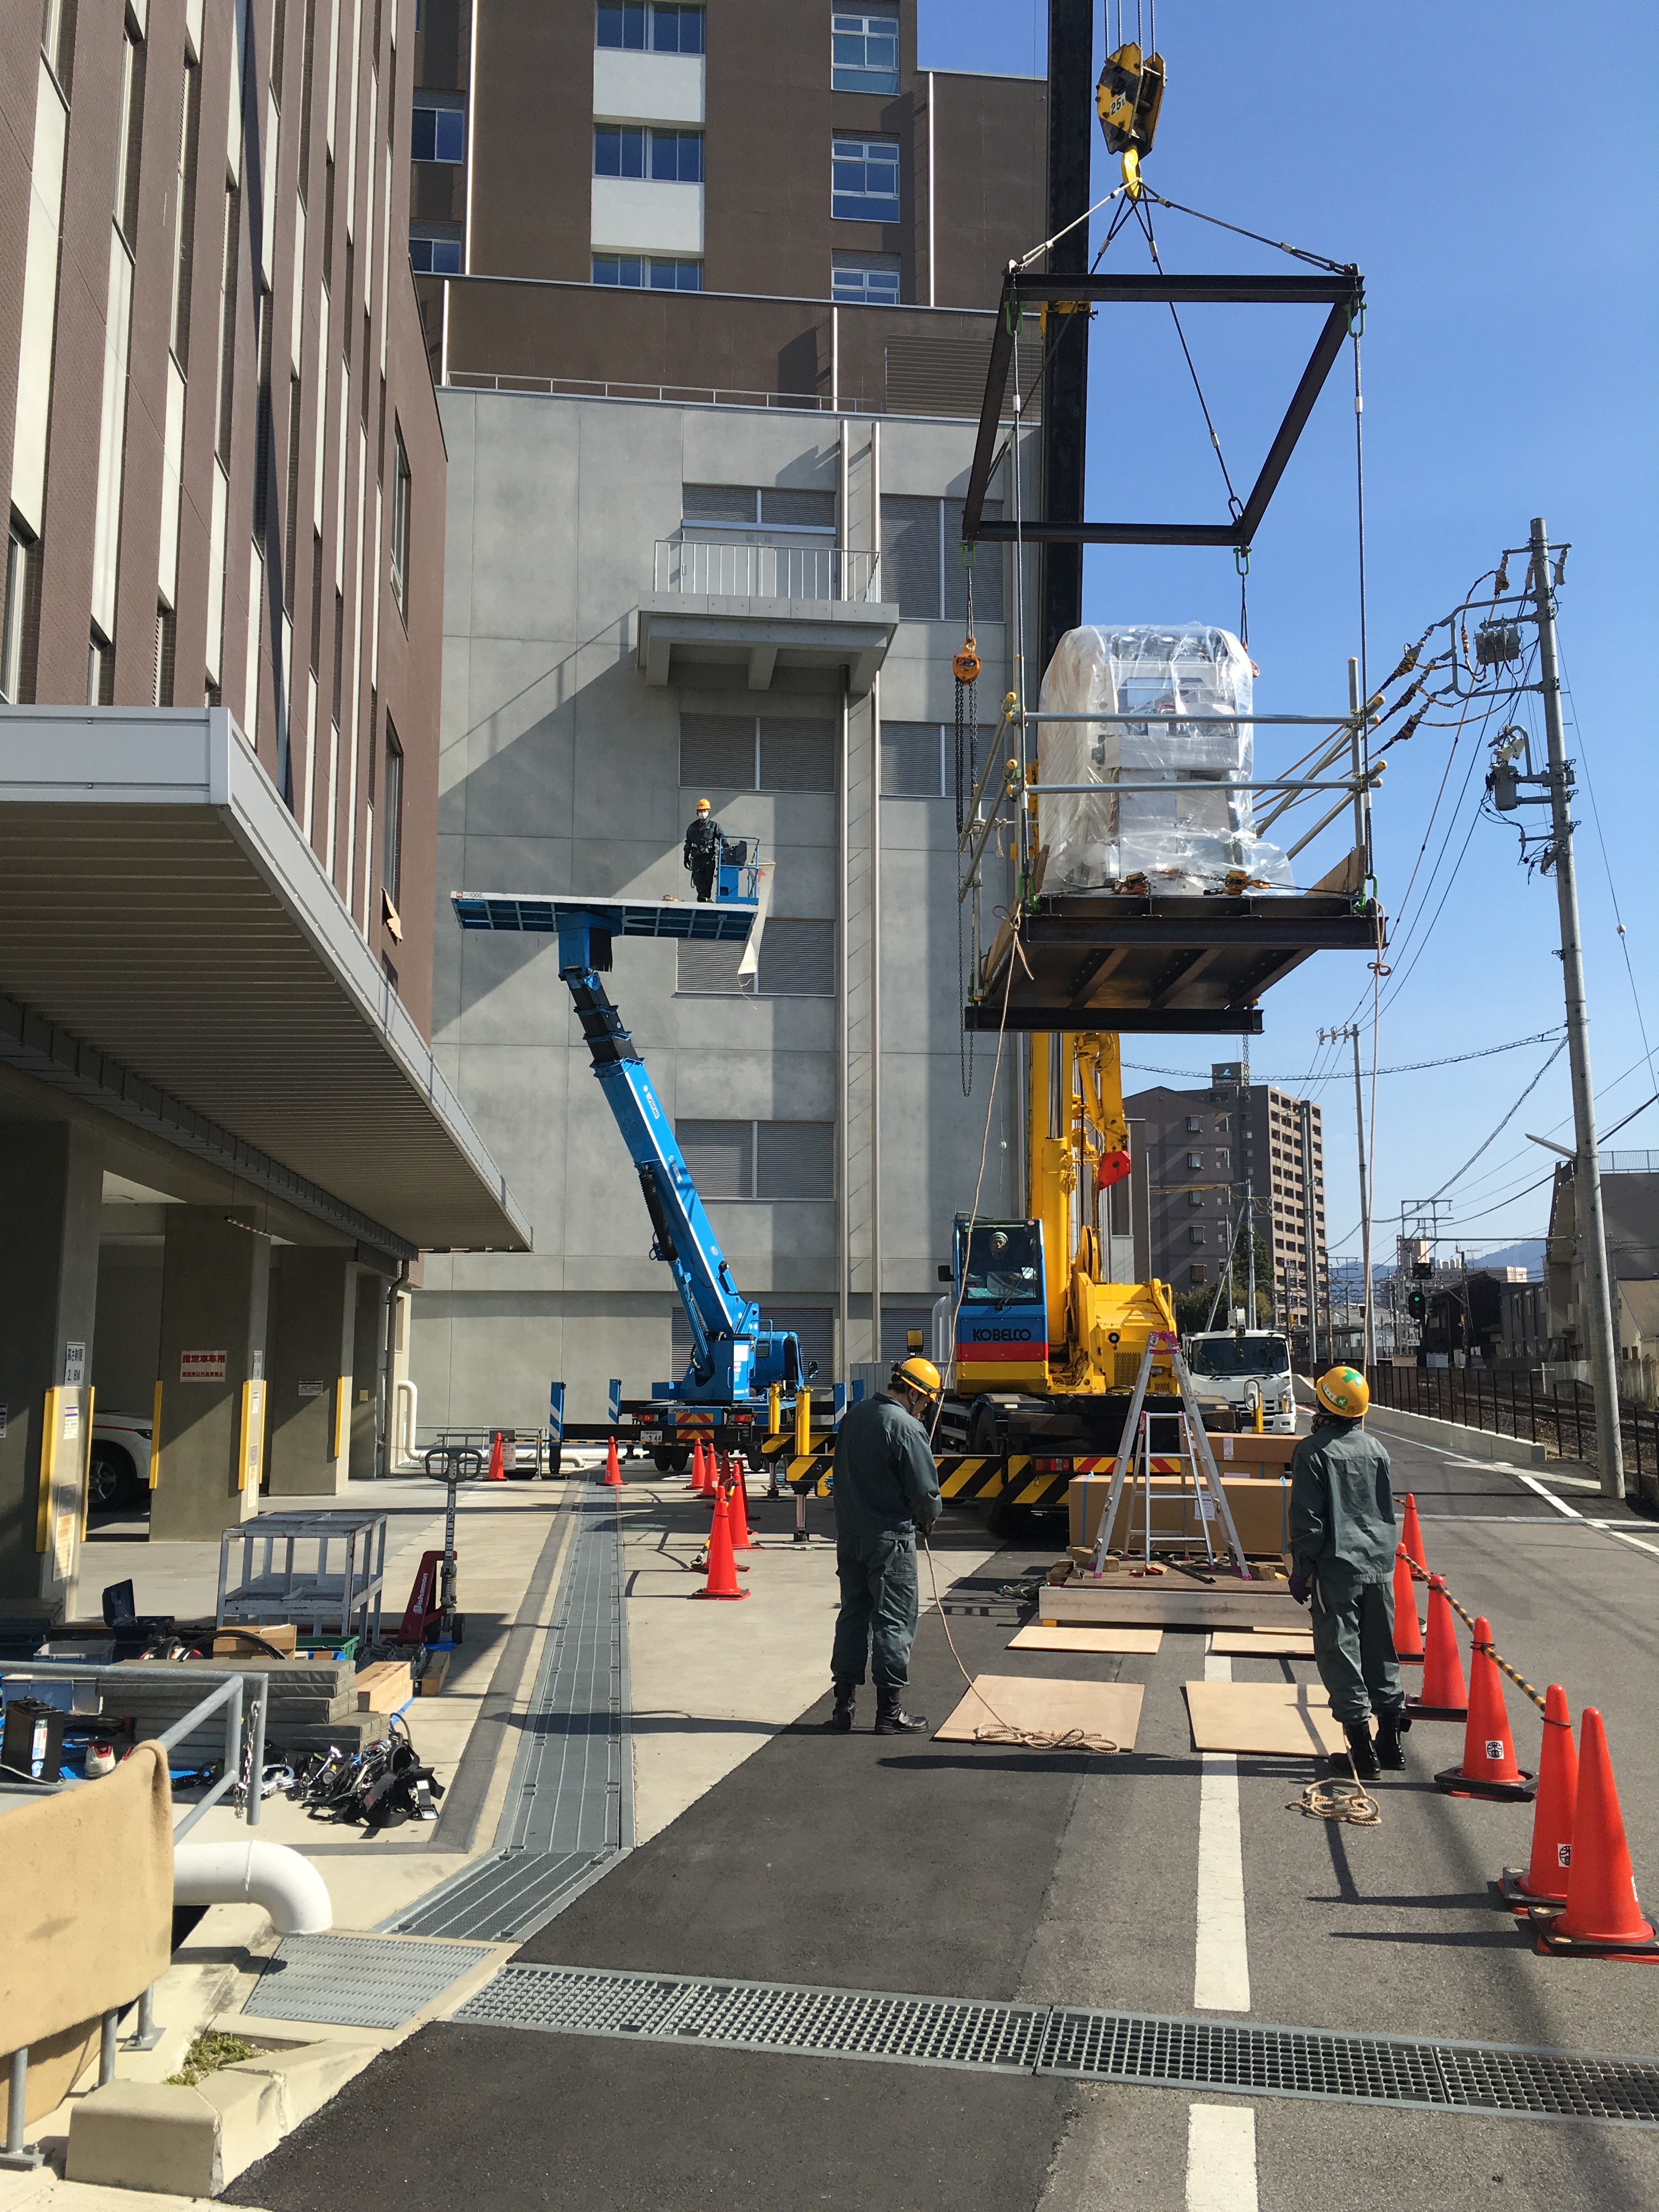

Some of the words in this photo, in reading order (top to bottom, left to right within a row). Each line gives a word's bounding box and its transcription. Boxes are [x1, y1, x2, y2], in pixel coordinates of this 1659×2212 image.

[1111, 96, 1125, 116] 25t
[973, 1328, 1031, 1341] KOBELCO
[182, 1355, 225, 1363] 指定車専用
